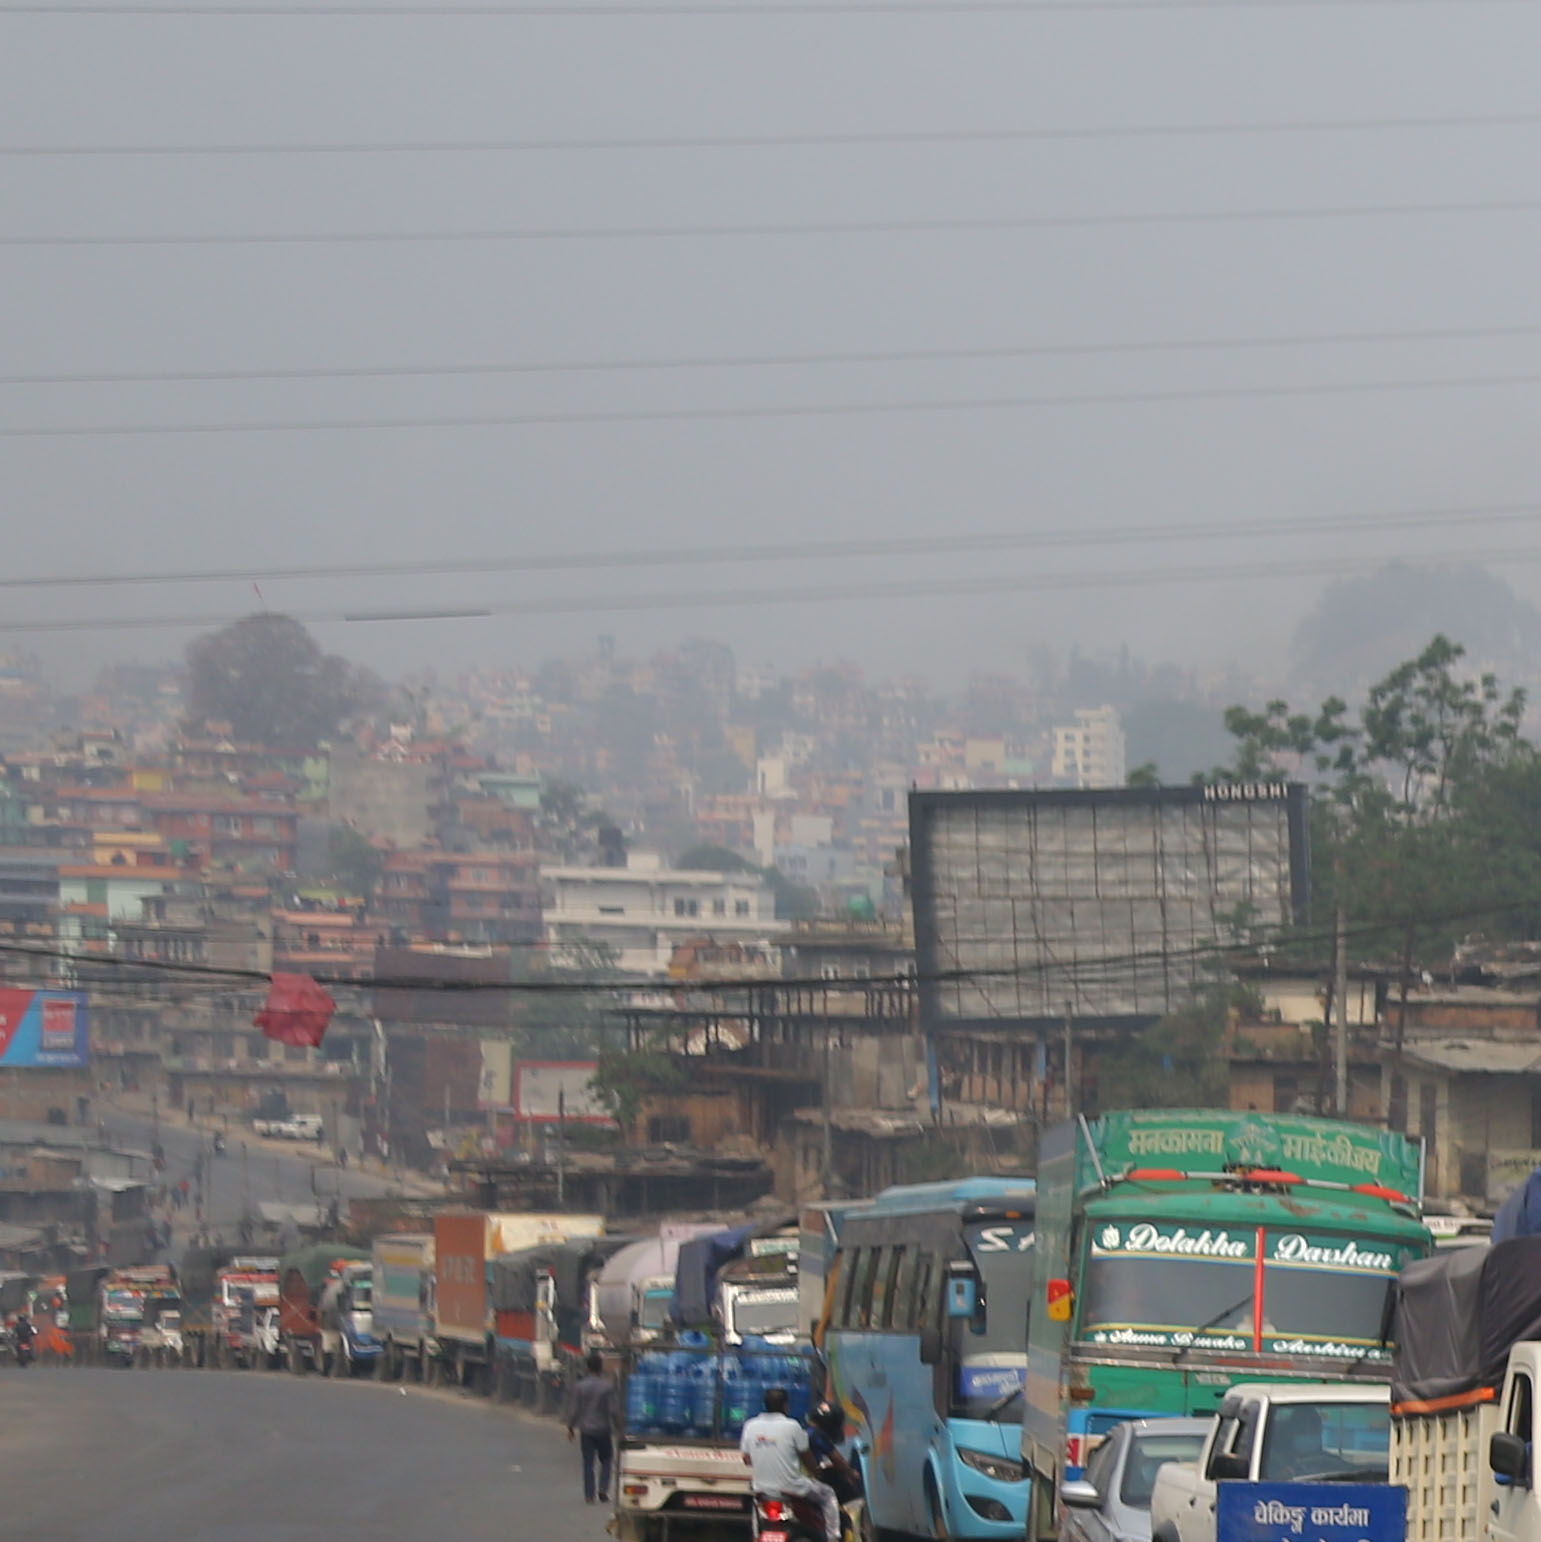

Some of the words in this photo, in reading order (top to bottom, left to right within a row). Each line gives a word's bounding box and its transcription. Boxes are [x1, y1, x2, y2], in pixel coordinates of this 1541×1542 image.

[1125, 1222, 1248, 1257] Dolakha
[1273, 1234, 1392, 1269] Darshan
[1311, 1502, 1370, 1528] कार्यमा
